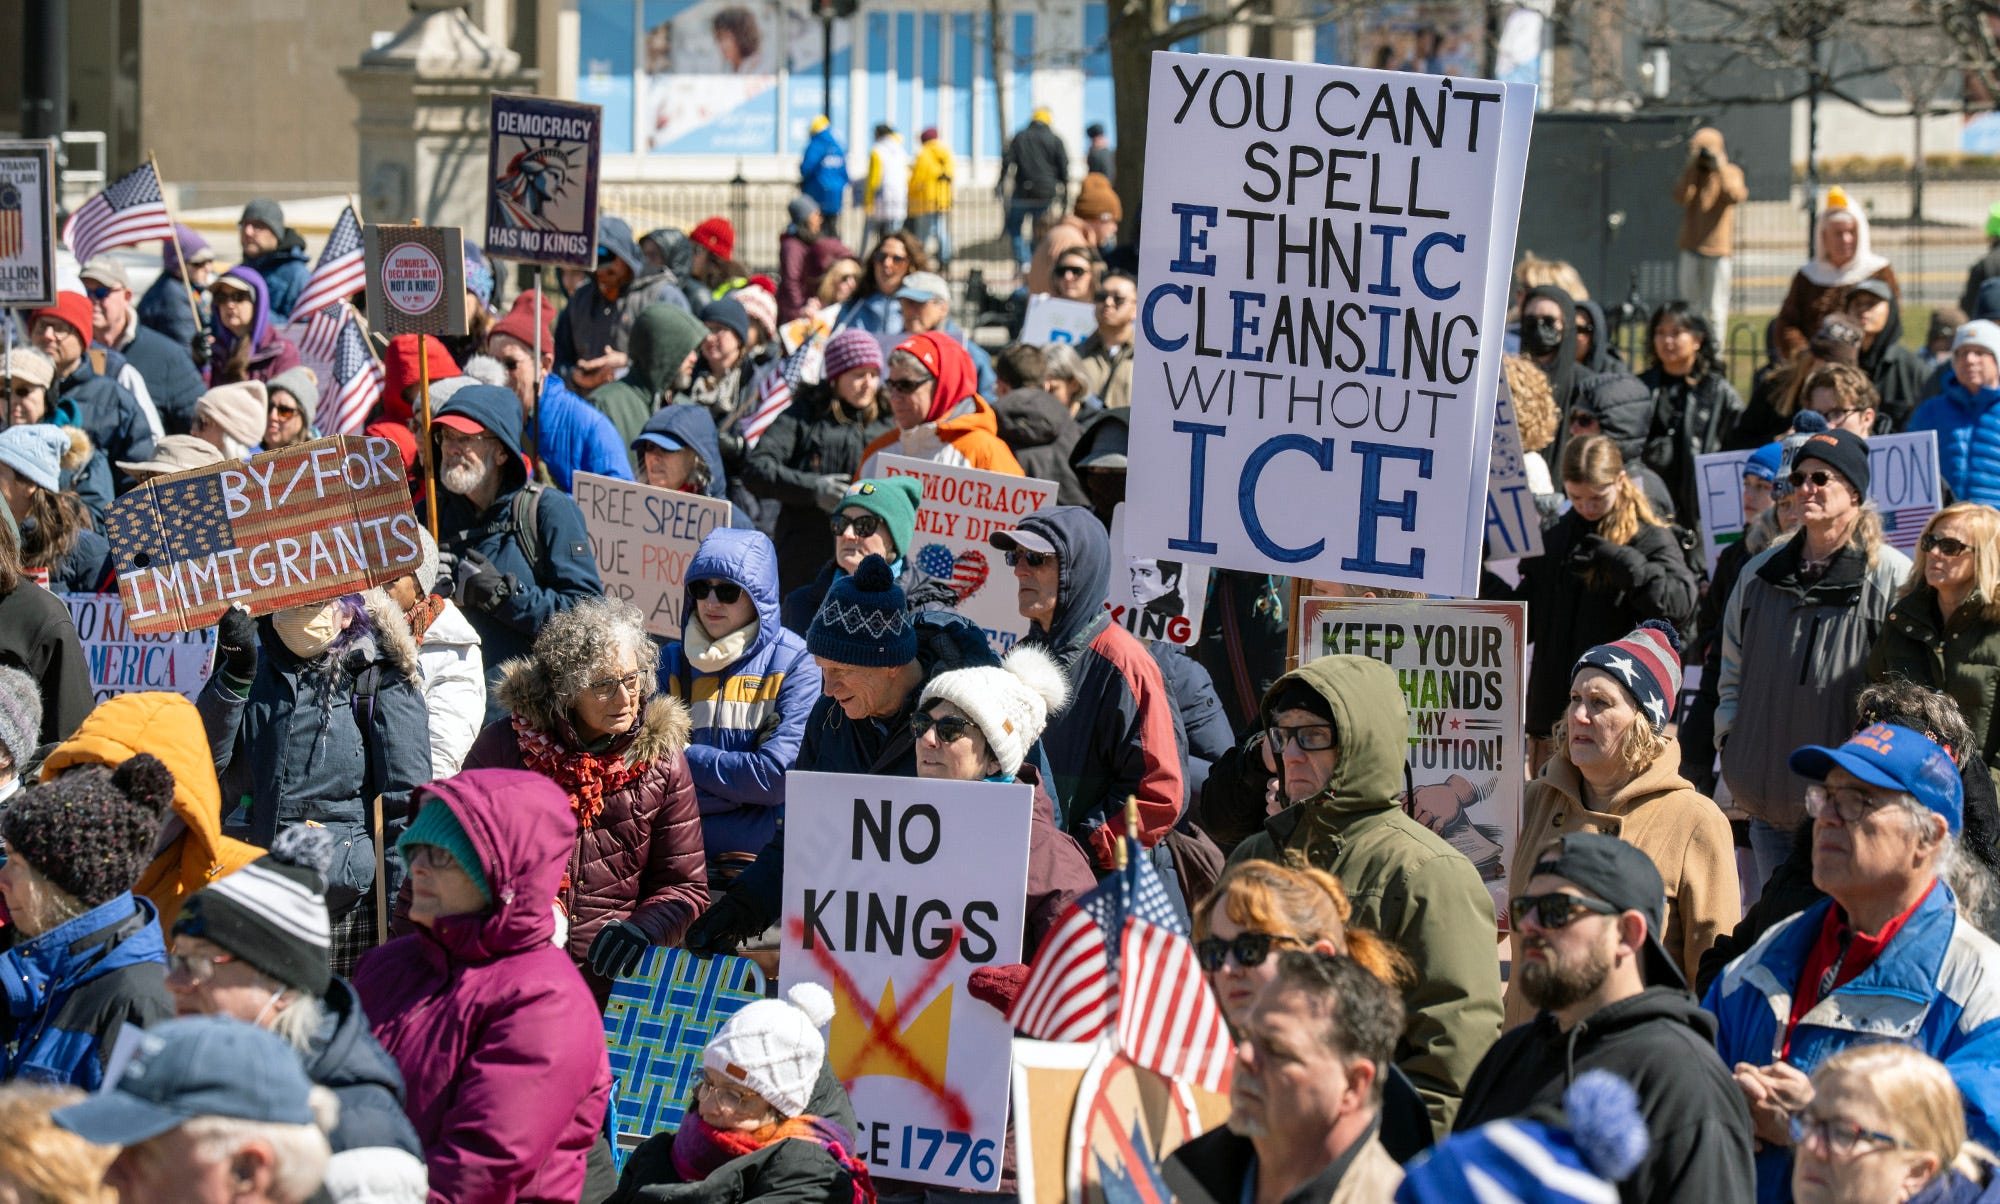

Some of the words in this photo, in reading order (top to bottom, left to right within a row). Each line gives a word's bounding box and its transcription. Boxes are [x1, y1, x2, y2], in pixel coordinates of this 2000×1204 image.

[498, 111, 592, 140] DEMOCRACY
[1172, 64, 1293, 133] YOU
[1315, 76, 1501, 153] CAN'T
[1242, 140, 1450, 220] SPELL
[395, 258, 429, 268] CONGRESS
[489, 227, 517, 248] HAS
[520, 230, 541, 251] NO
[543, 234, 588, 256] KINGS
[1169, 202, 1467, 301] ETHNIC
[388, 269, 421, 279] DECLARES
[422, 270, 437, 279] WAR
[390, 281, 406, 292] NOT
[407, 281, 413, 292] A
[415, 281, 437, 292] KING!
[1141, 282, 1480, 385] CLEANSING
[1163, 361, 1458, 438] WITHOUT
[576, 481, 637, 528] FREE
[914, 508, 960, 537] NLY
[1167, 419, 1434, 579] ICE
[1484, 485, 1531, 553] AT
[119, 513, 419, 621] IMMIGRANTS
[83, 645, 177, 688] MERICA
[1321, 622, 1405, 664] KEEP
[1413, 624, 1503, 668] YOUR
[1398, 668, 1503, 711] HANDS
[1417, 711, 1447, 736] MY
[1407, 735, 1503, 772] TUTION!
[851, 798, 941, 865] NO
[801, 887, 999, 964] KINGS
[900, 1123, 996, 1184] 1776
